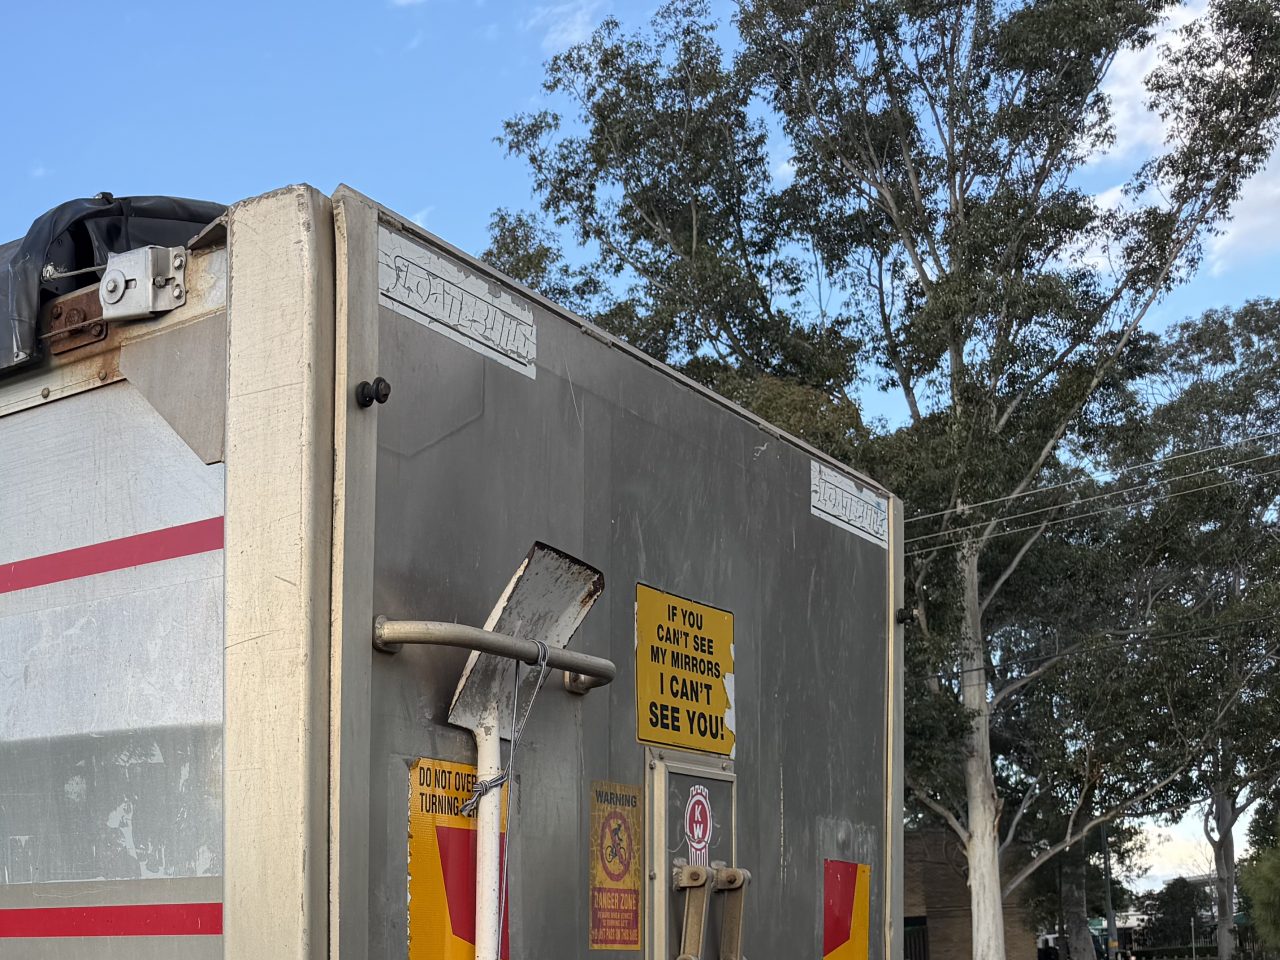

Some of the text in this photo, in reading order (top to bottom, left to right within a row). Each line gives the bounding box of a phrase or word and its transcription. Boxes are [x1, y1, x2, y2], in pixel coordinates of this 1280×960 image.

[667, 604, 703, 631] IF YOU
[656, 624, 714, 656] CAN'T SEE
[650, 645, 721, 679] MY MIRRORS
[659, 672, 712, 705] I CAN'T
[649, 701, 724, 740] SEE YOU!
[419, 767, 432, 788] DO
[434, 768, 452, 790] NOT
[419, 793, 459, 816] TURNING
[595, 789, 637, 808] WARNING
